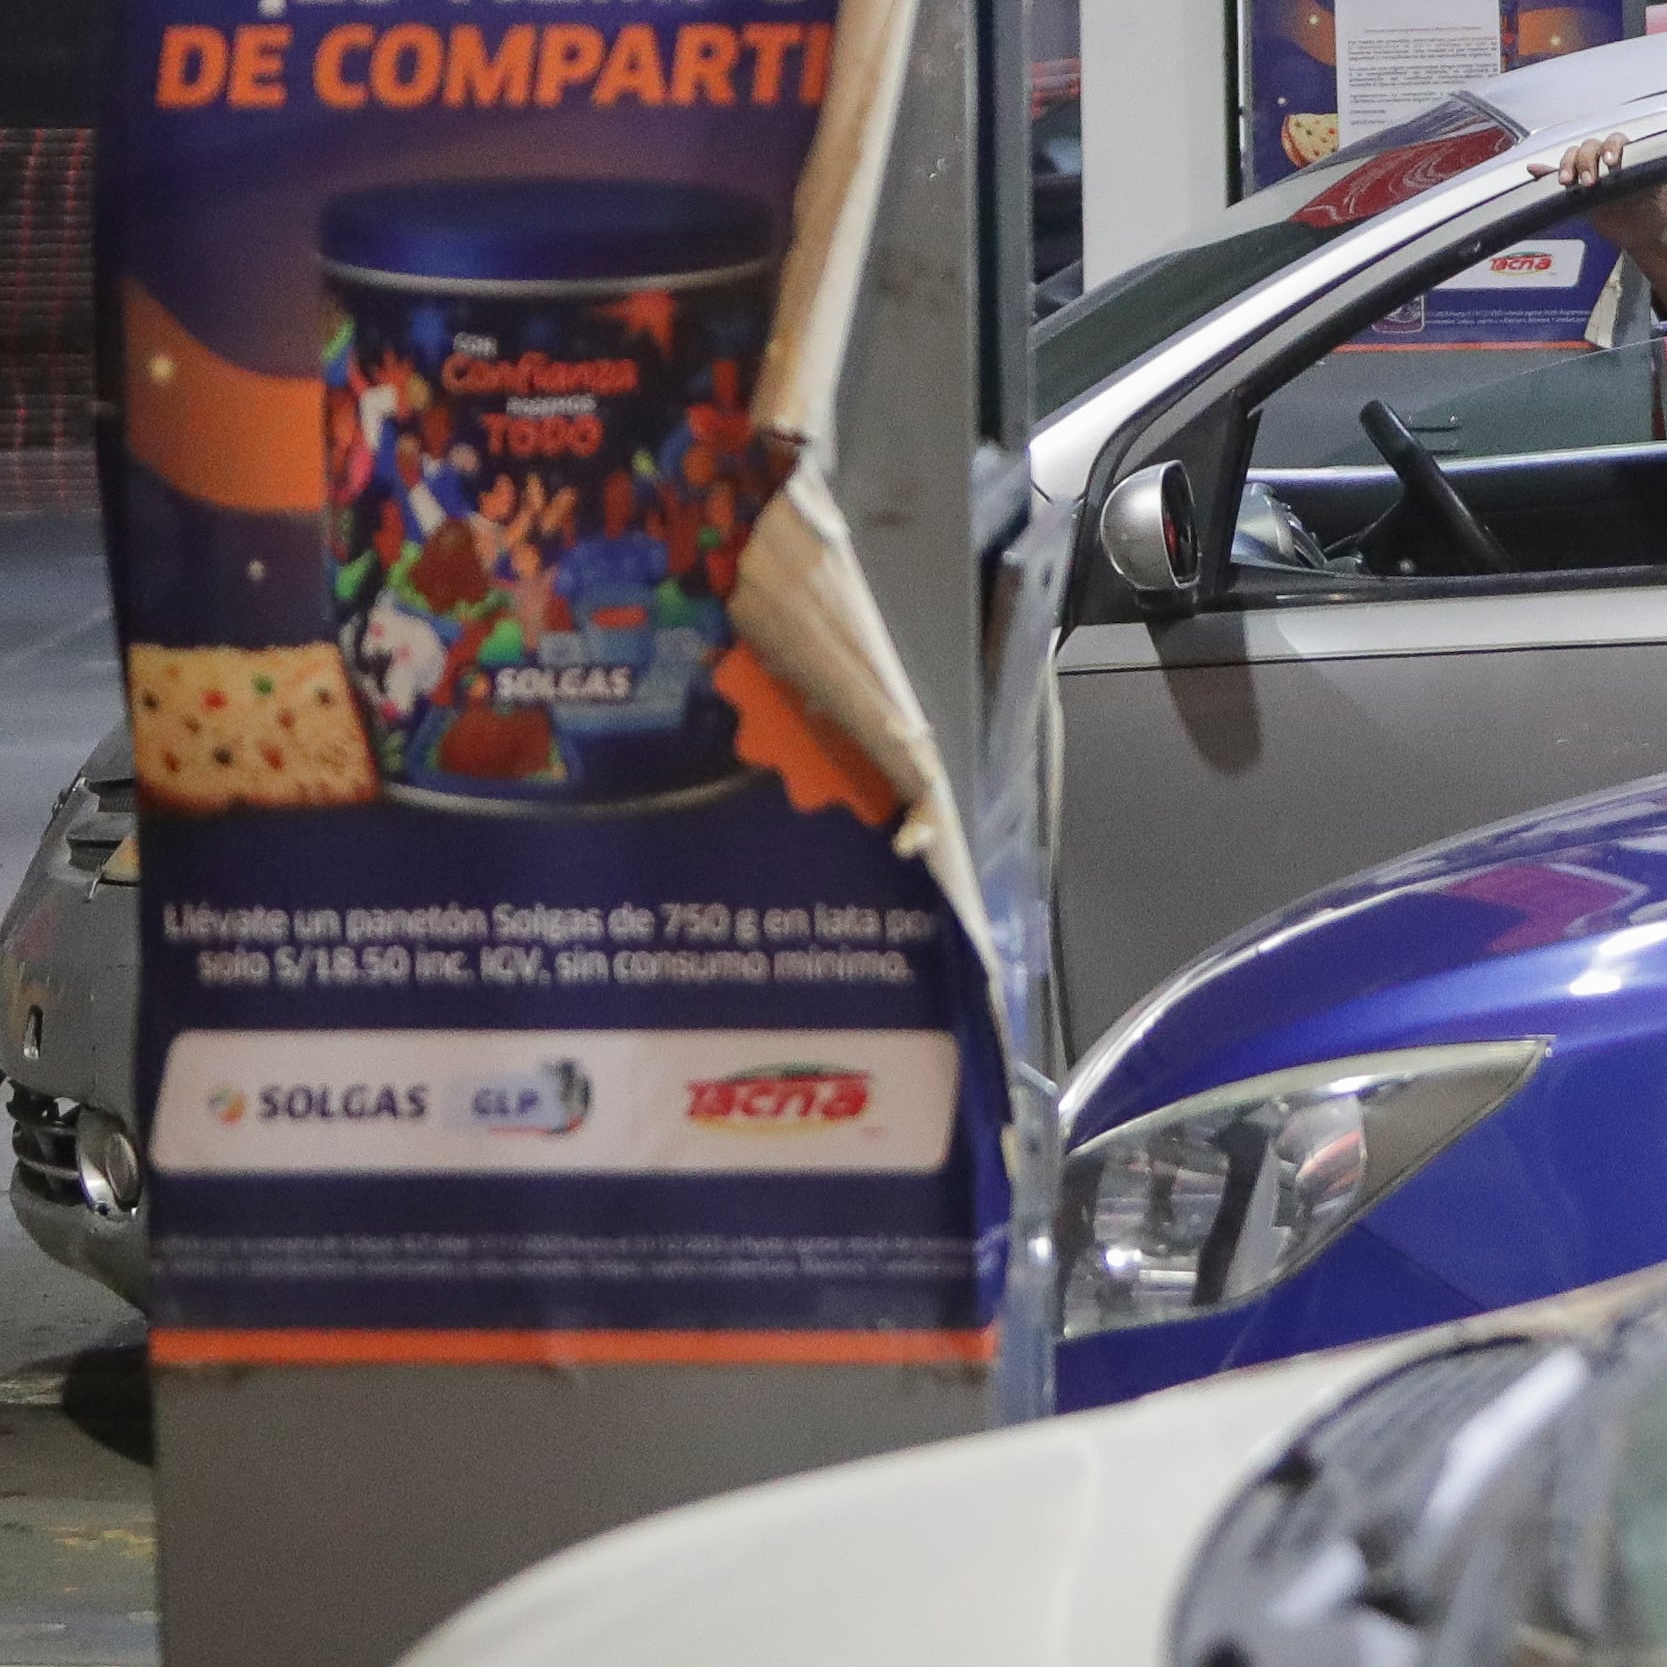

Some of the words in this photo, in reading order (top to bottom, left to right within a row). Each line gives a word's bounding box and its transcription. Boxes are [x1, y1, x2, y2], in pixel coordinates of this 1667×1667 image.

[155, 22, 293, 111] DE
[312, 19, 834, 110] COMPARTI
[480, 412, 606, 458] TODO
[494, 665, 632, 700] SOLGAS
[163, 901, 291, 940] Llévate
[294, 908, 342, 940] un
[345, 901, 488, 945] panetón
[492, 901, 604, 946] Solgas
[607, 901, 656, 940] de
[659, 902, 732, 941] 750
[734, 908, 760, 947] g
[763, 908, 811, 940] en
[814, 901, 882, 940] lata
[884, 908, 934, 945] po
[197, 946, 270, 985] solo
[273, 944, 411, 987] S/18.50
[555, 945, 610, 984] sin
[612, 949, 770, 985] consumo
[772, 945, 915, 985] mínimo.
[257, 1083, 429, 1120] SOLGAS
[471, 1086, 540, 1117] GLP
